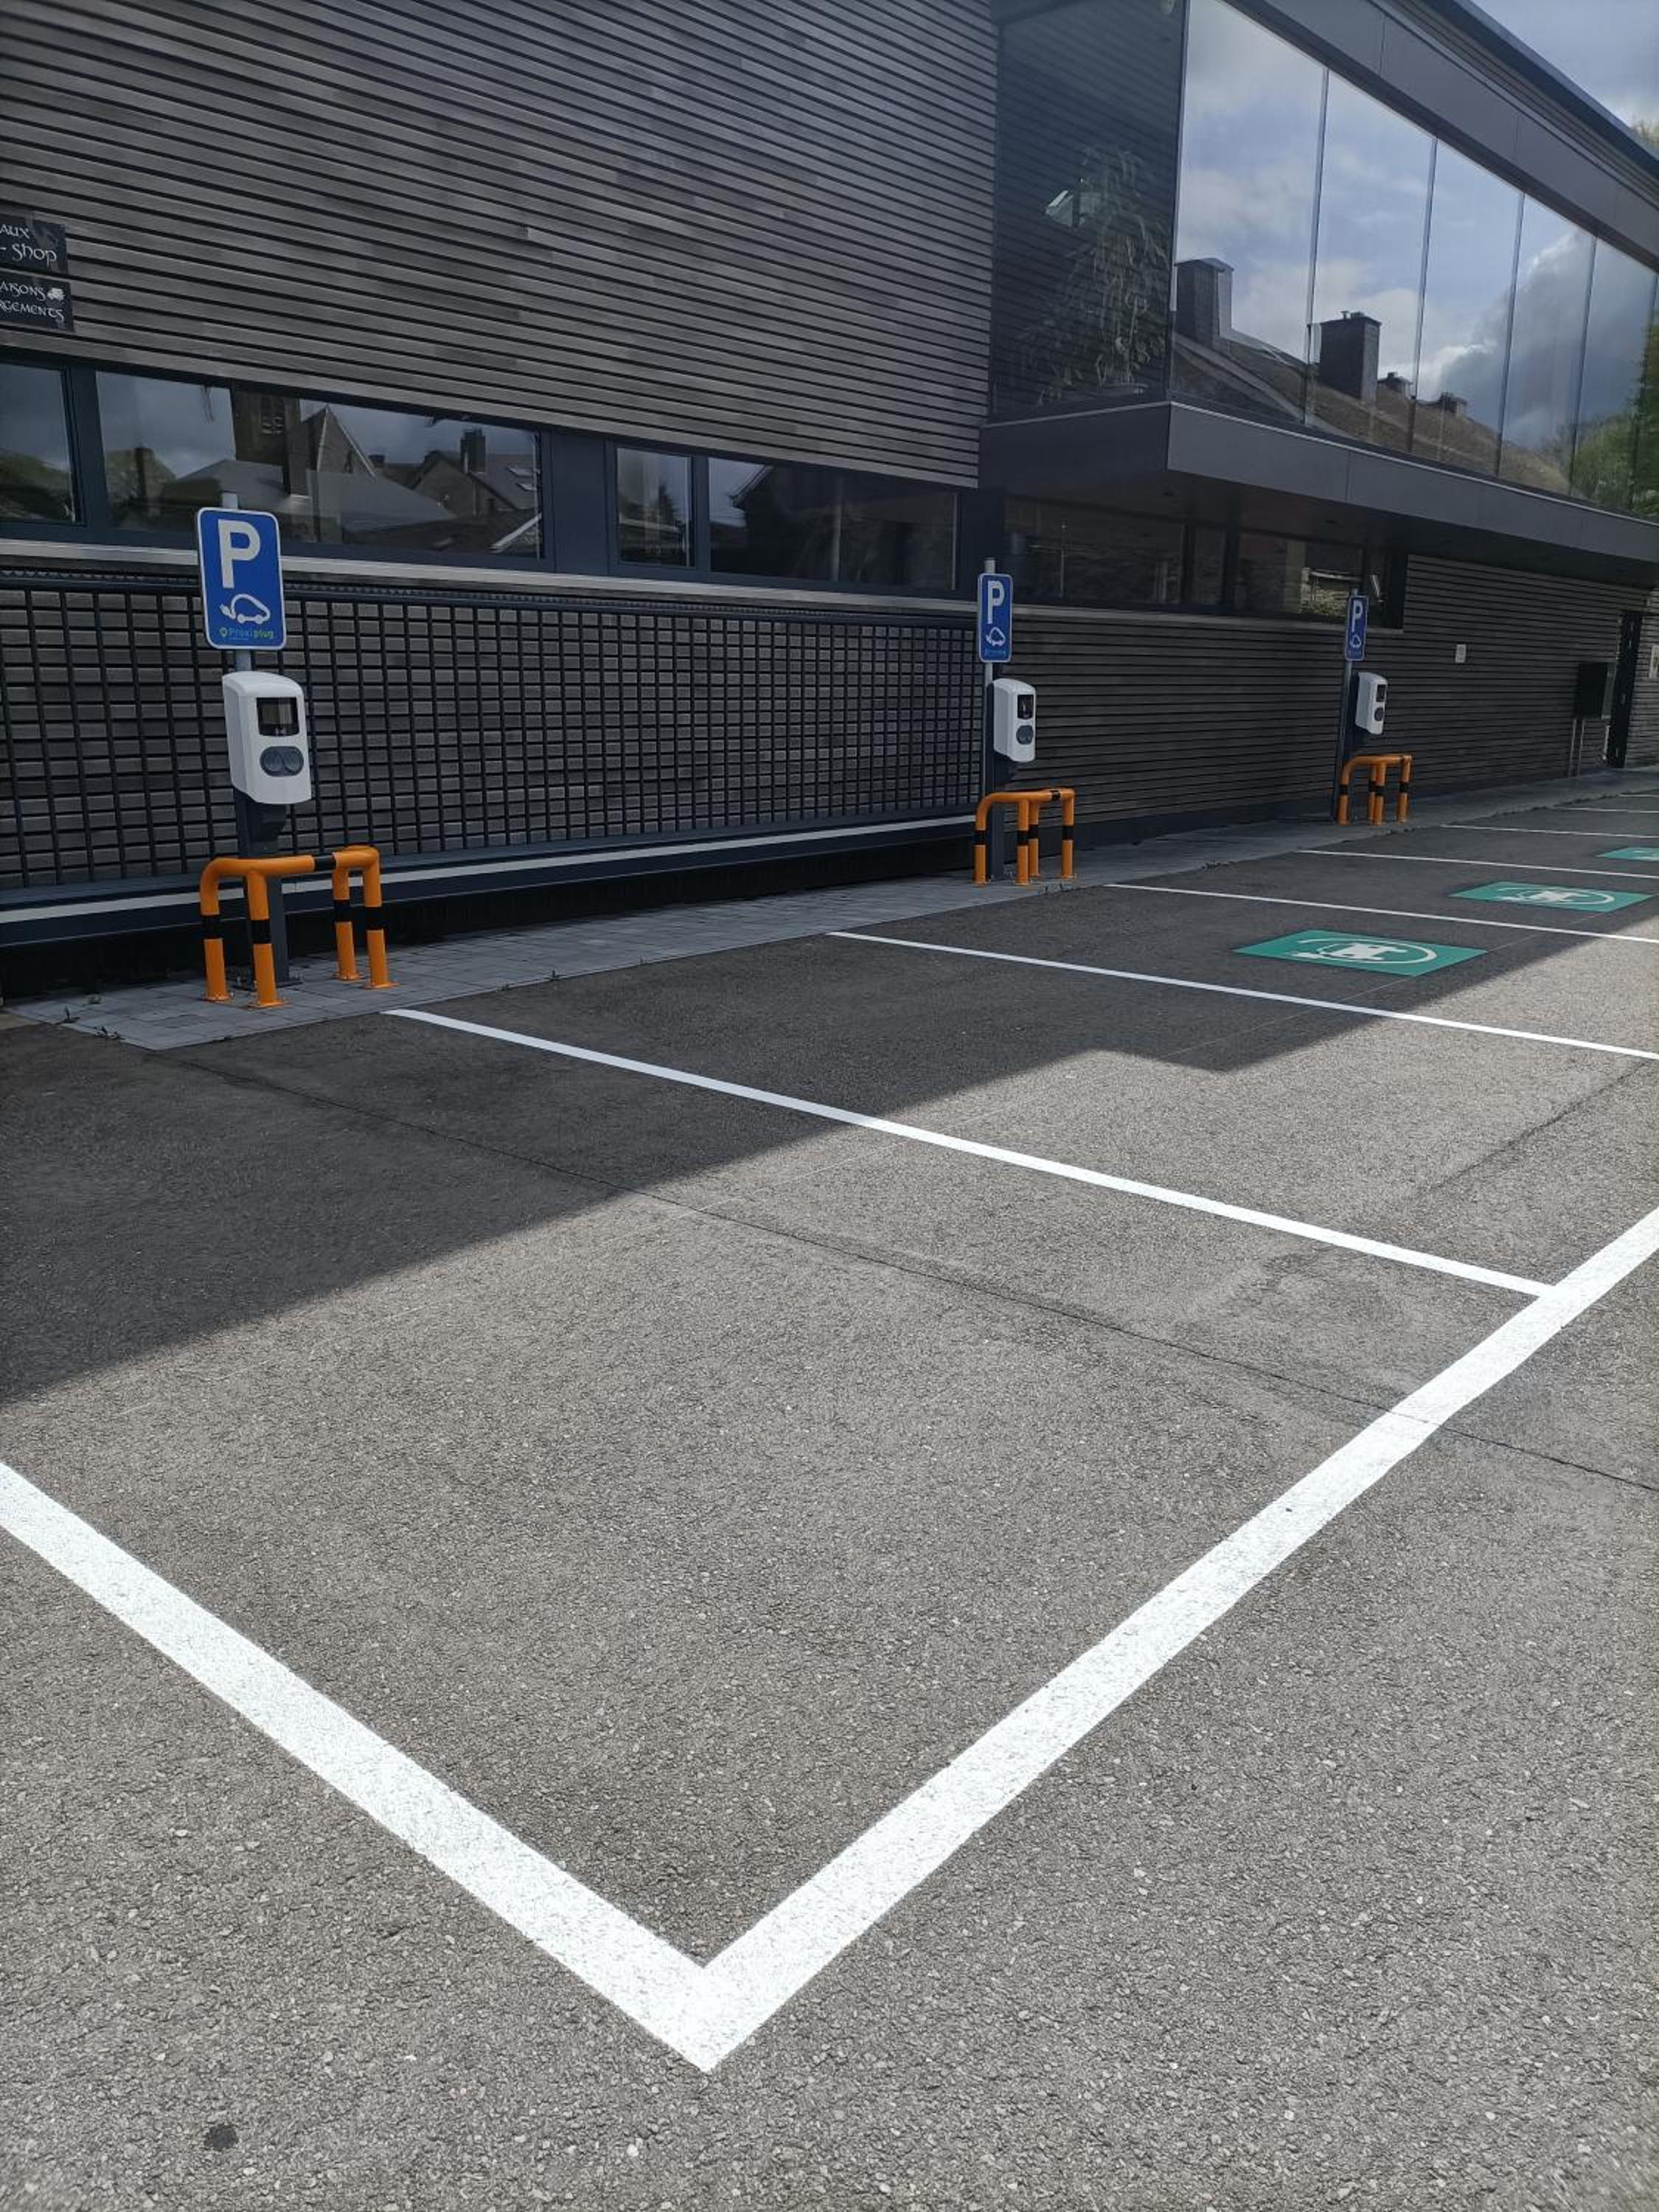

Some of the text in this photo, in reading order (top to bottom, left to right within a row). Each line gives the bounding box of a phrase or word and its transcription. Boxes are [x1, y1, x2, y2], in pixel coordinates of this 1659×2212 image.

[0, 223, 29, 239] AUX
[218, 519, 260, 588] P
[987, 580, 1005, 625] P
[1352, 600, 1363, 633] P
